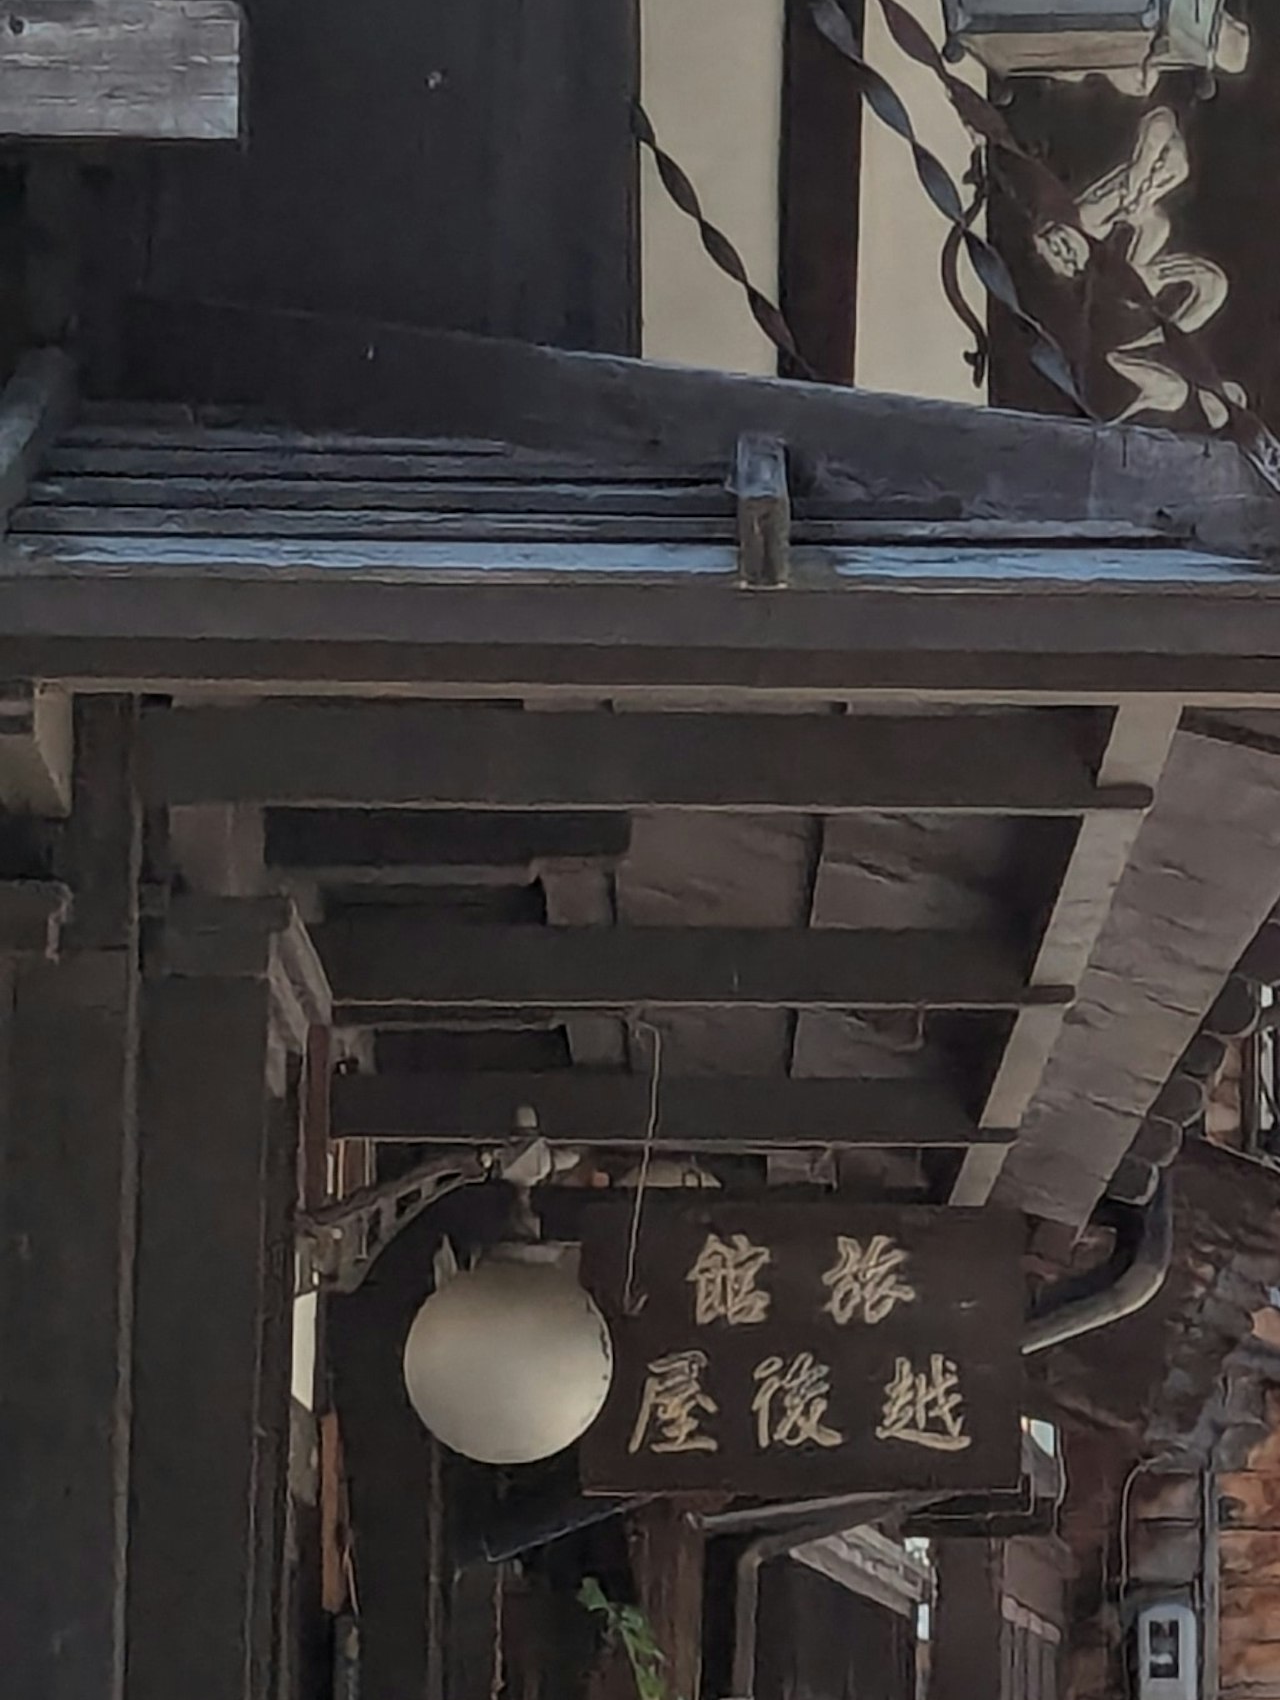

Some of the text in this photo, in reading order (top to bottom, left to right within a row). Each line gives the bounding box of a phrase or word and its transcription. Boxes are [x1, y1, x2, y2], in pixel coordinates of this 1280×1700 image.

[685, 1232, 917, 1326] 旅館
[627, 1348, 972, 1455] 越後屋
